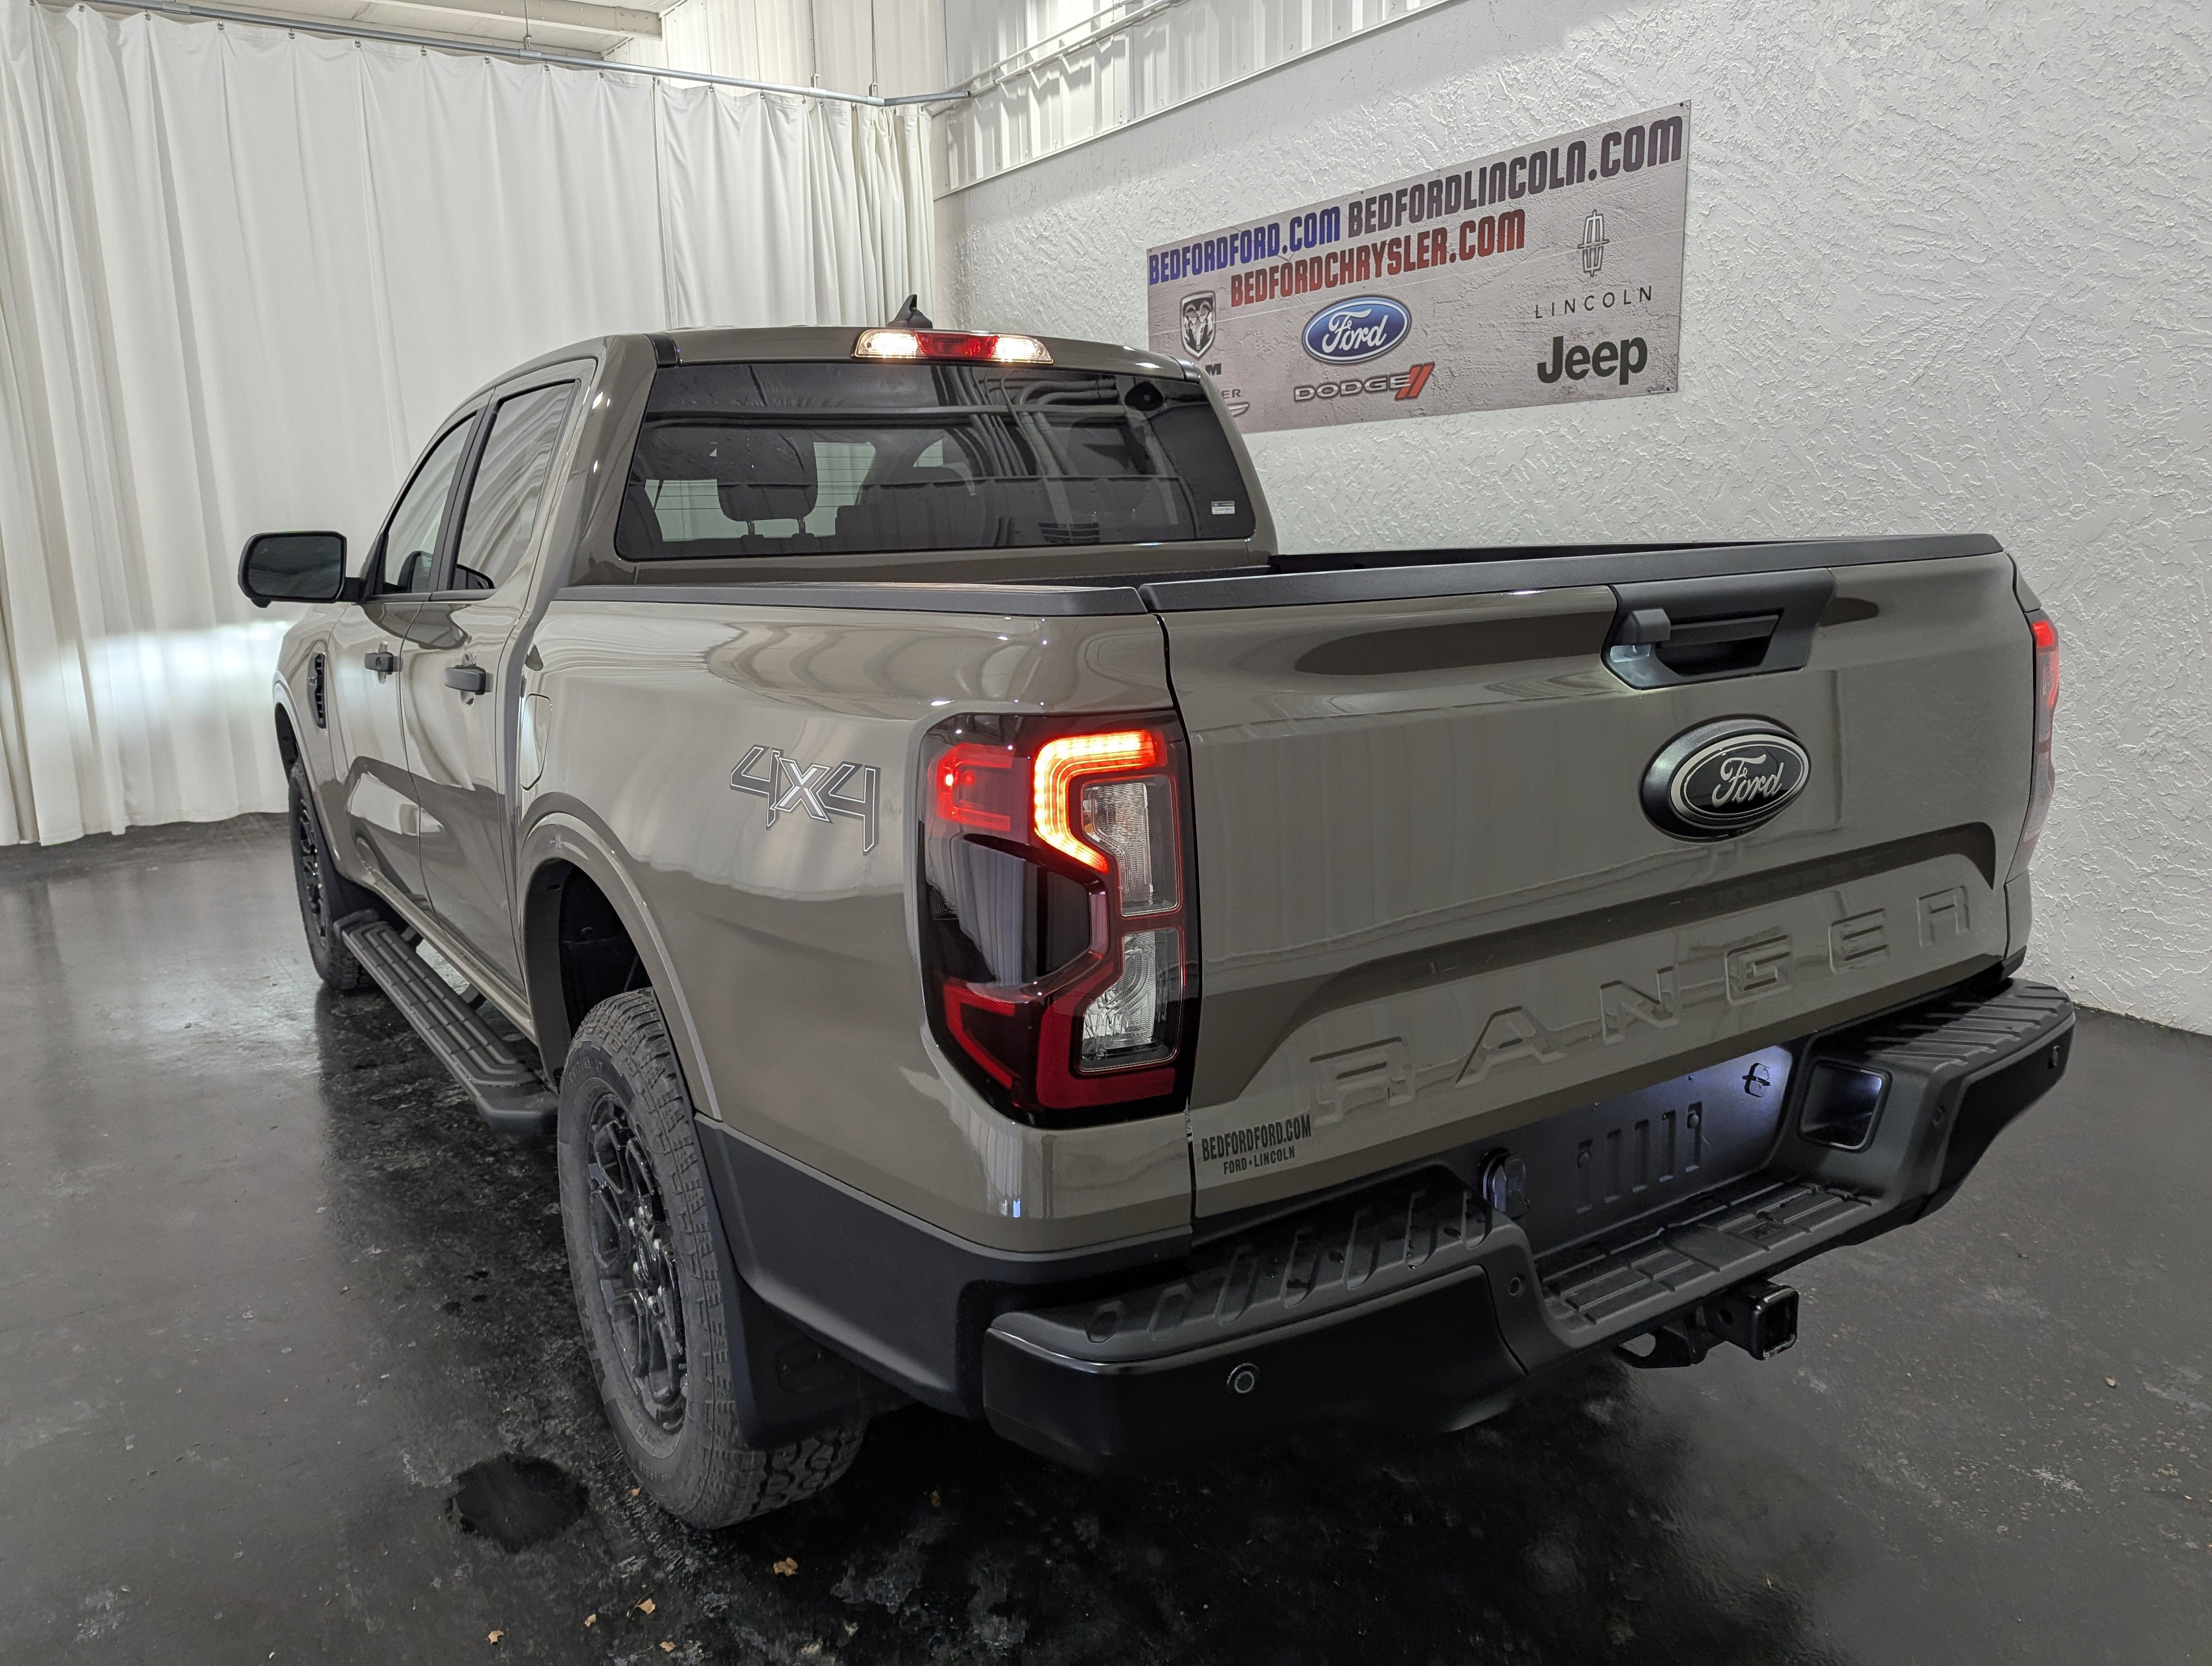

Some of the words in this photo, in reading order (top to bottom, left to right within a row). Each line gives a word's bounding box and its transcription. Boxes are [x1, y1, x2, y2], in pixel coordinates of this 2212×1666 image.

[1149, 206, 1341, 286] BEDFORDFORD.COM
[1347, 115, 1684, 238] BEDFORDLINCOLN.COM
[1230, 208, 1526, 307] BEDFORDCHRYSLER.COM
[1535, 285, 1652, 319] LINCOLN
[1322, 308, 1389, 353] Ford
[1536, 336, 1648, 385] Jeep
[1294, 373, 1412, 402] DODGE
[1711, 754, 1784, 808] Ford
[1308, 884, 1971, 1129] RANGER
[1201, 1114, 1311, 1161] BEDFORDFORD.COM
[1223, 1158, 1248, 1175] FORD
[1254, 1145, 1295, 1168] LINCOLN
